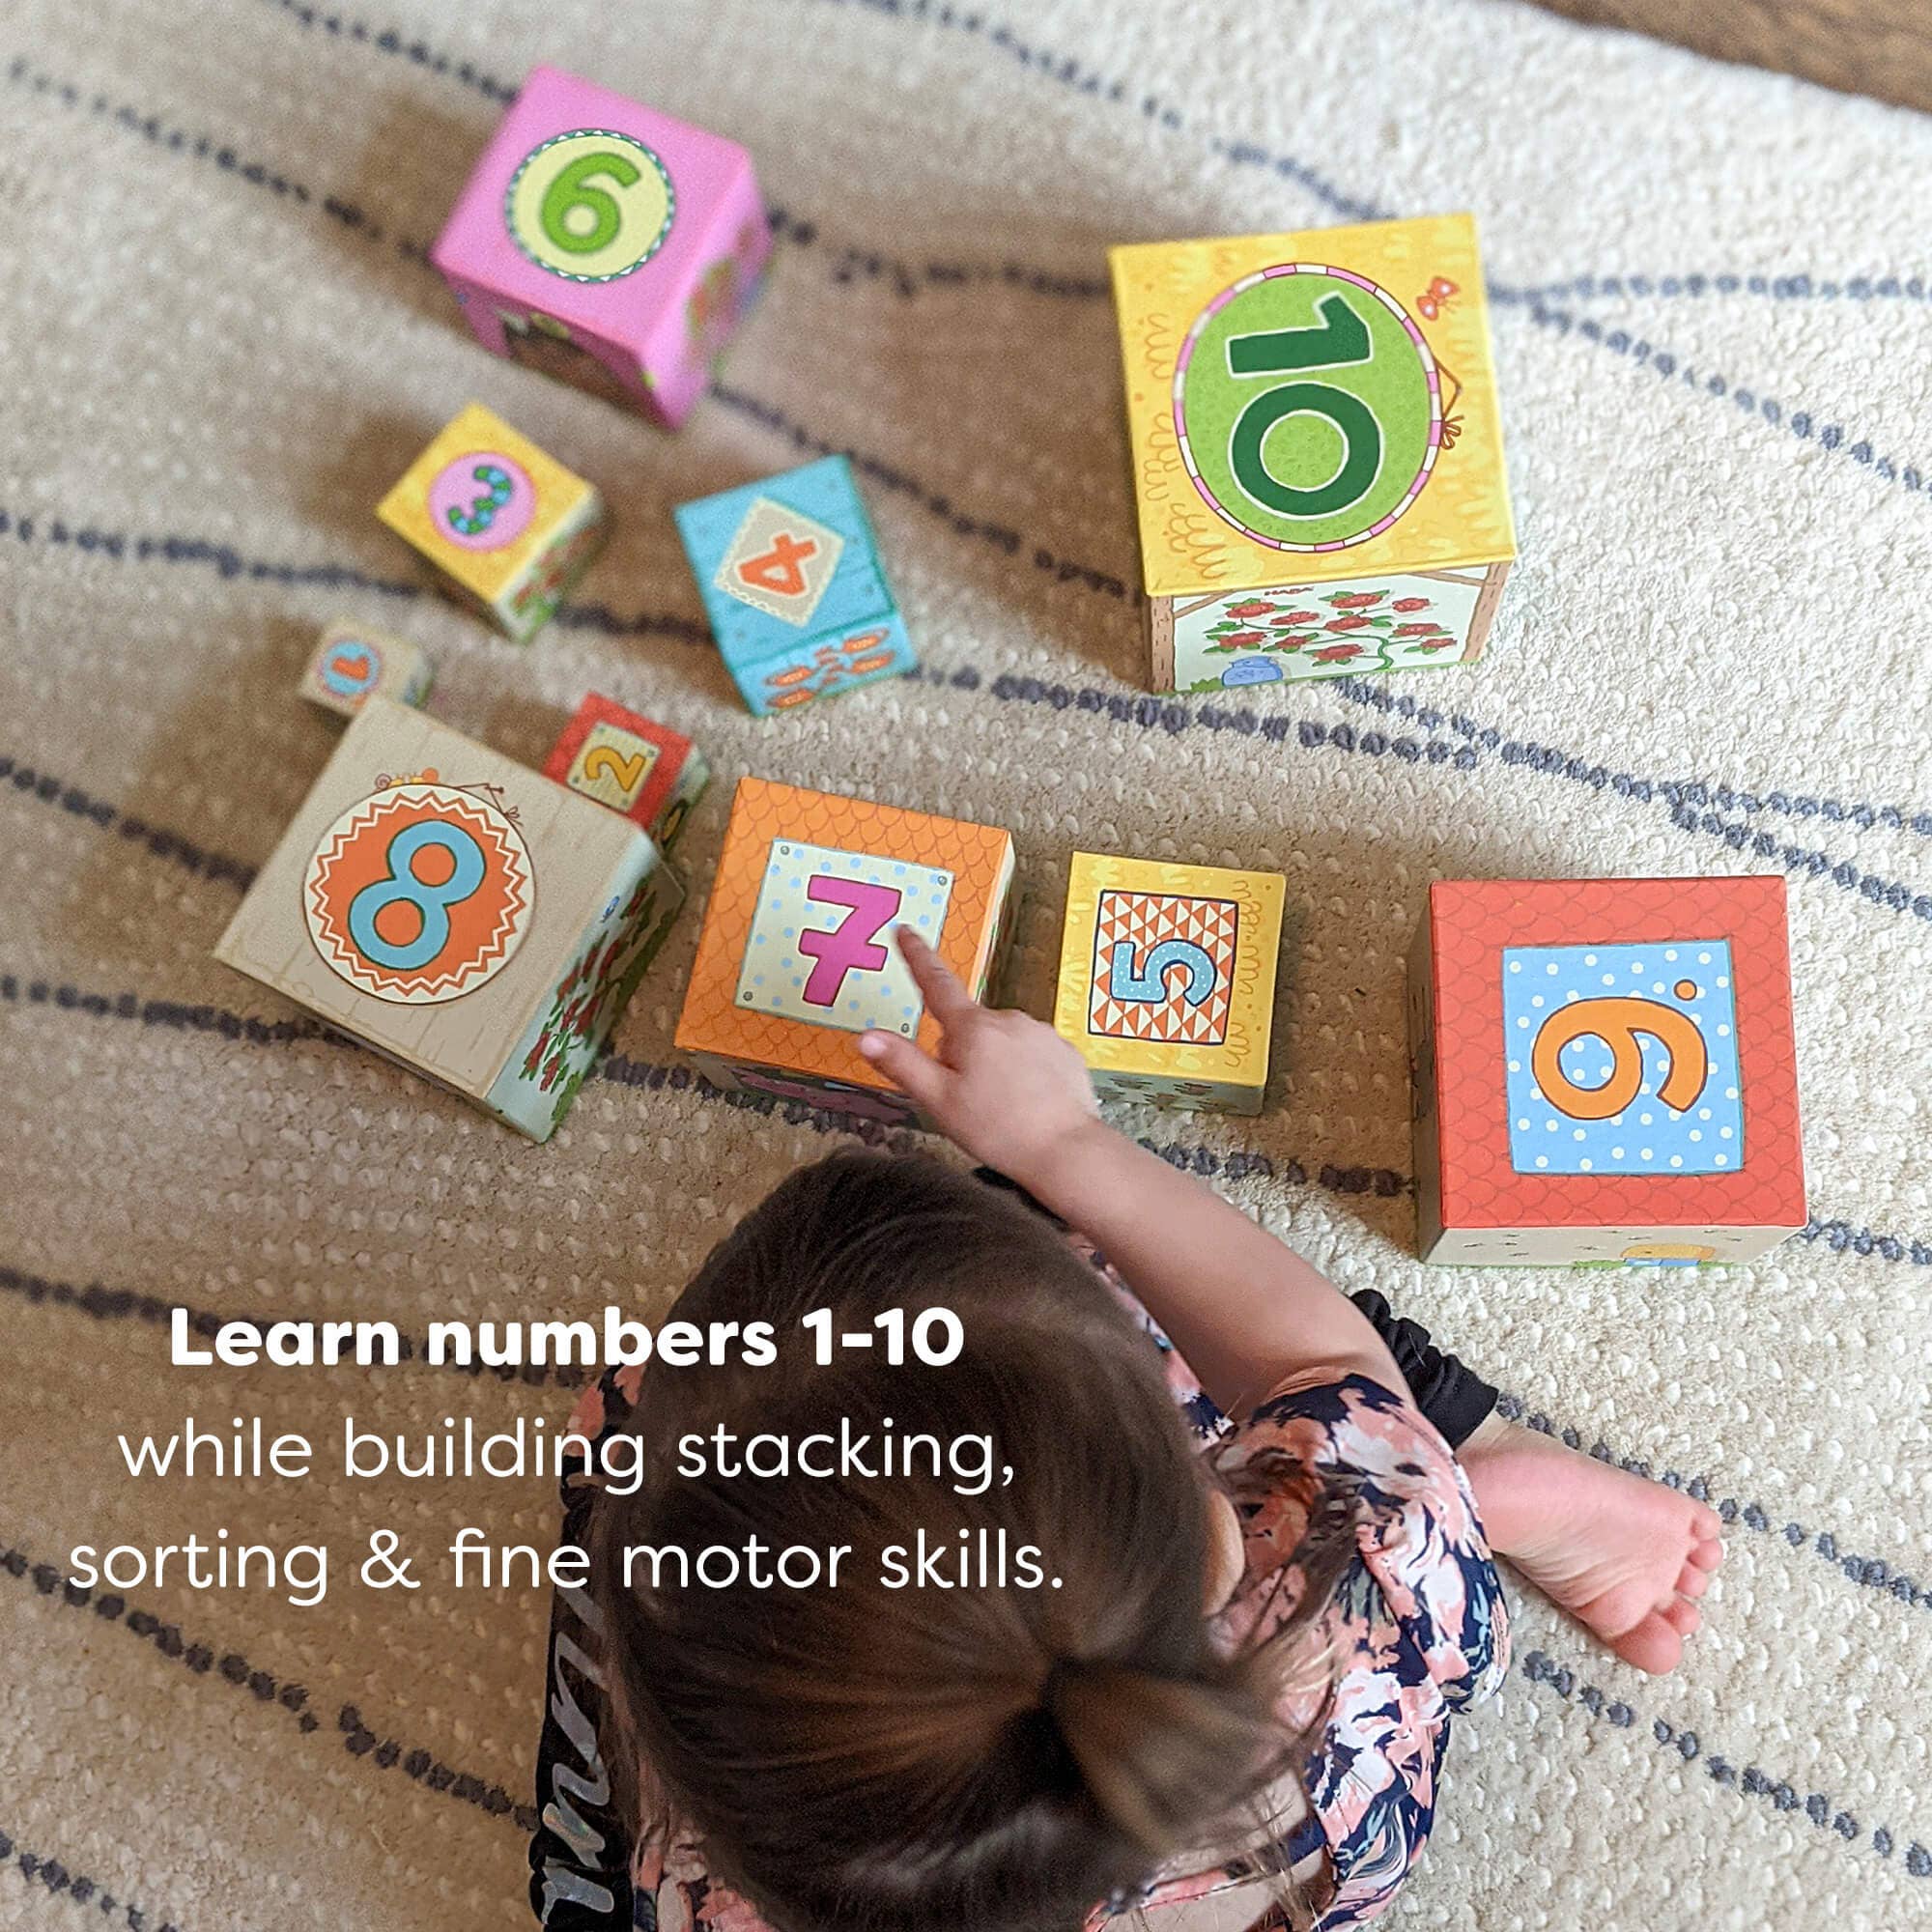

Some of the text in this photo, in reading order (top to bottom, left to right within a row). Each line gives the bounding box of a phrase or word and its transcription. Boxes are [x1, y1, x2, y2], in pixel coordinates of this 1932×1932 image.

[541, 151, 641, 255] 6
[1225, 291, 1385, 520] 10
[446, 465, 514, 535] 3
[737, 533, 817, 597] 4
[583, 745, 646, 792] 2
[348, 819, 487, 971] 8
[798, 874, 902, 1008] 7
[1110, 938, 1219, 1008] 5
